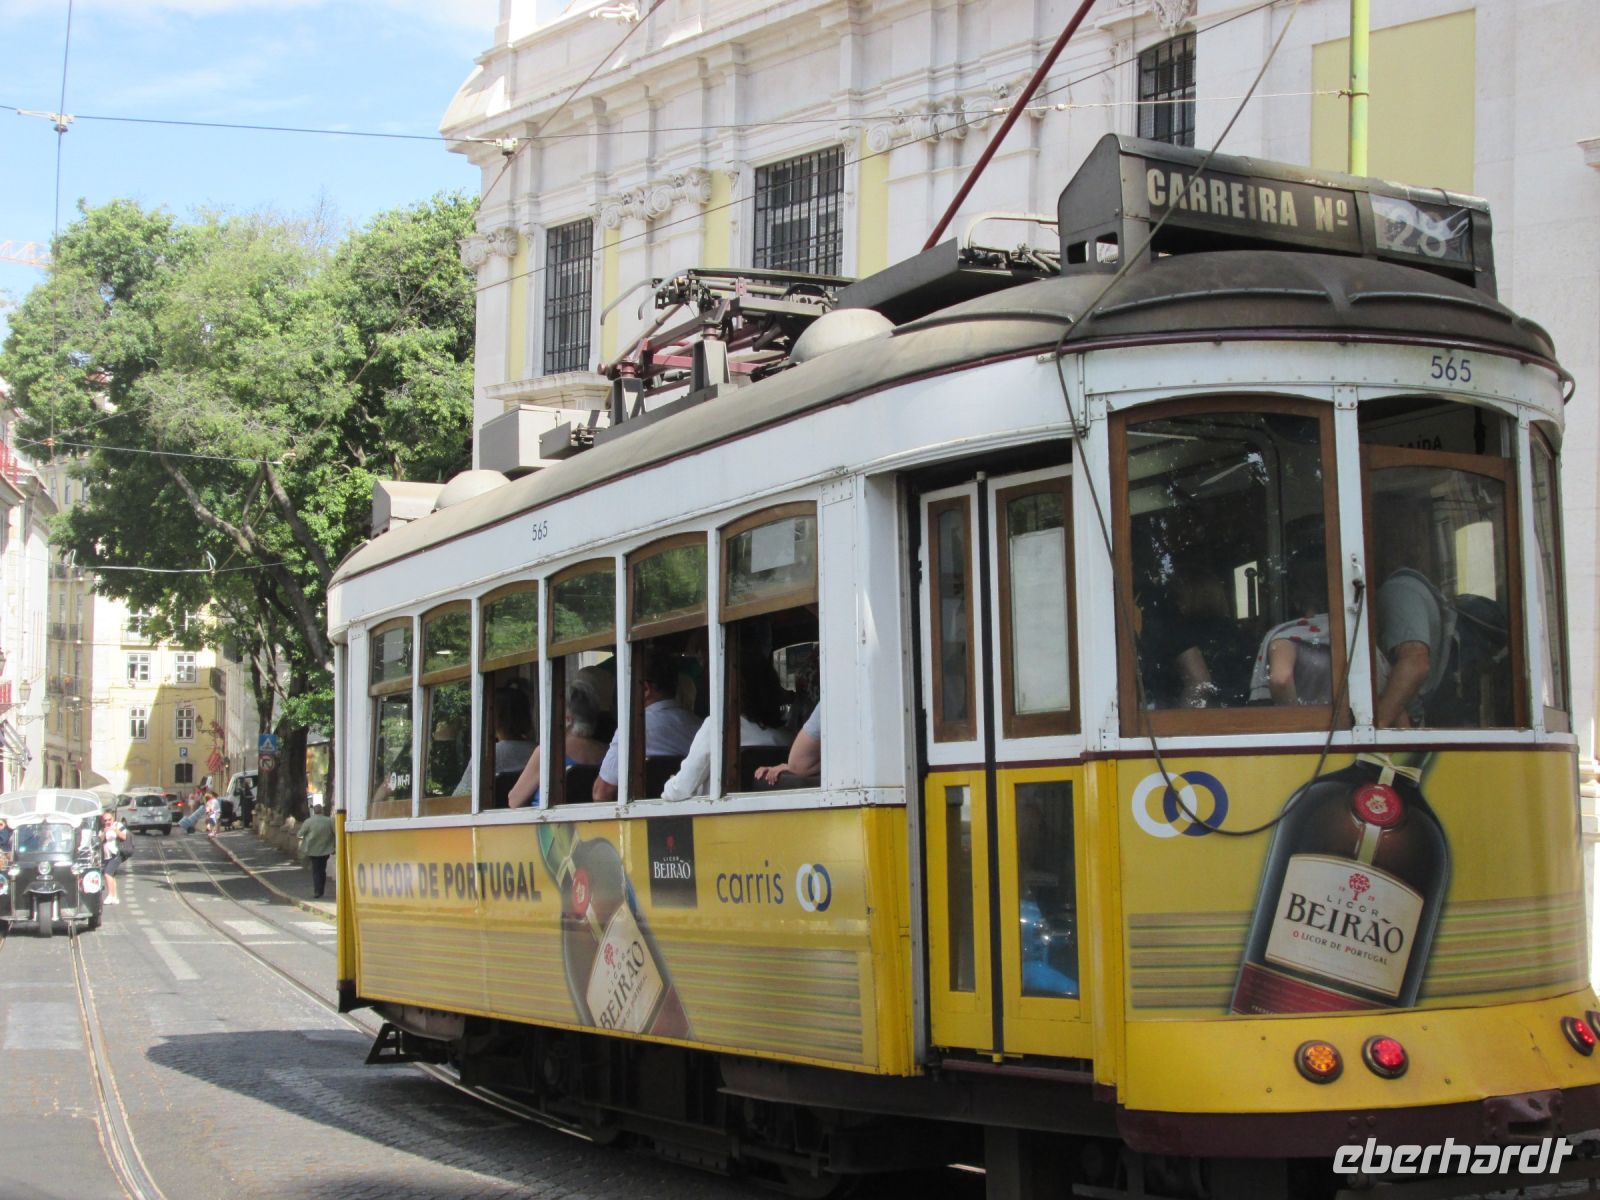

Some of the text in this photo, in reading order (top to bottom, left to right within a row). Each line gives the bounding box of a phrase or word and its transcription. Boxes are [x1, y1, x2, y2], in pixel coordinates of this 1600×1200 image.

[1146, 168, 1298, 227] CARREIRA
[1431, 355, 1472, 382] 565
[532, 520, 548, 541] 565
[357, 861, 542, 901] O LICOR DE PORTUGAL
[653, 859, 691, 880] BEIRÃO
[716, 859, 785, 905] carris
[1284, 892, 1405, 954] BEIRÃO
[1326, 895, 1380, 917] LICOR
[1292, 930, 1388, 965] O LICOR DE PORTUGAL
